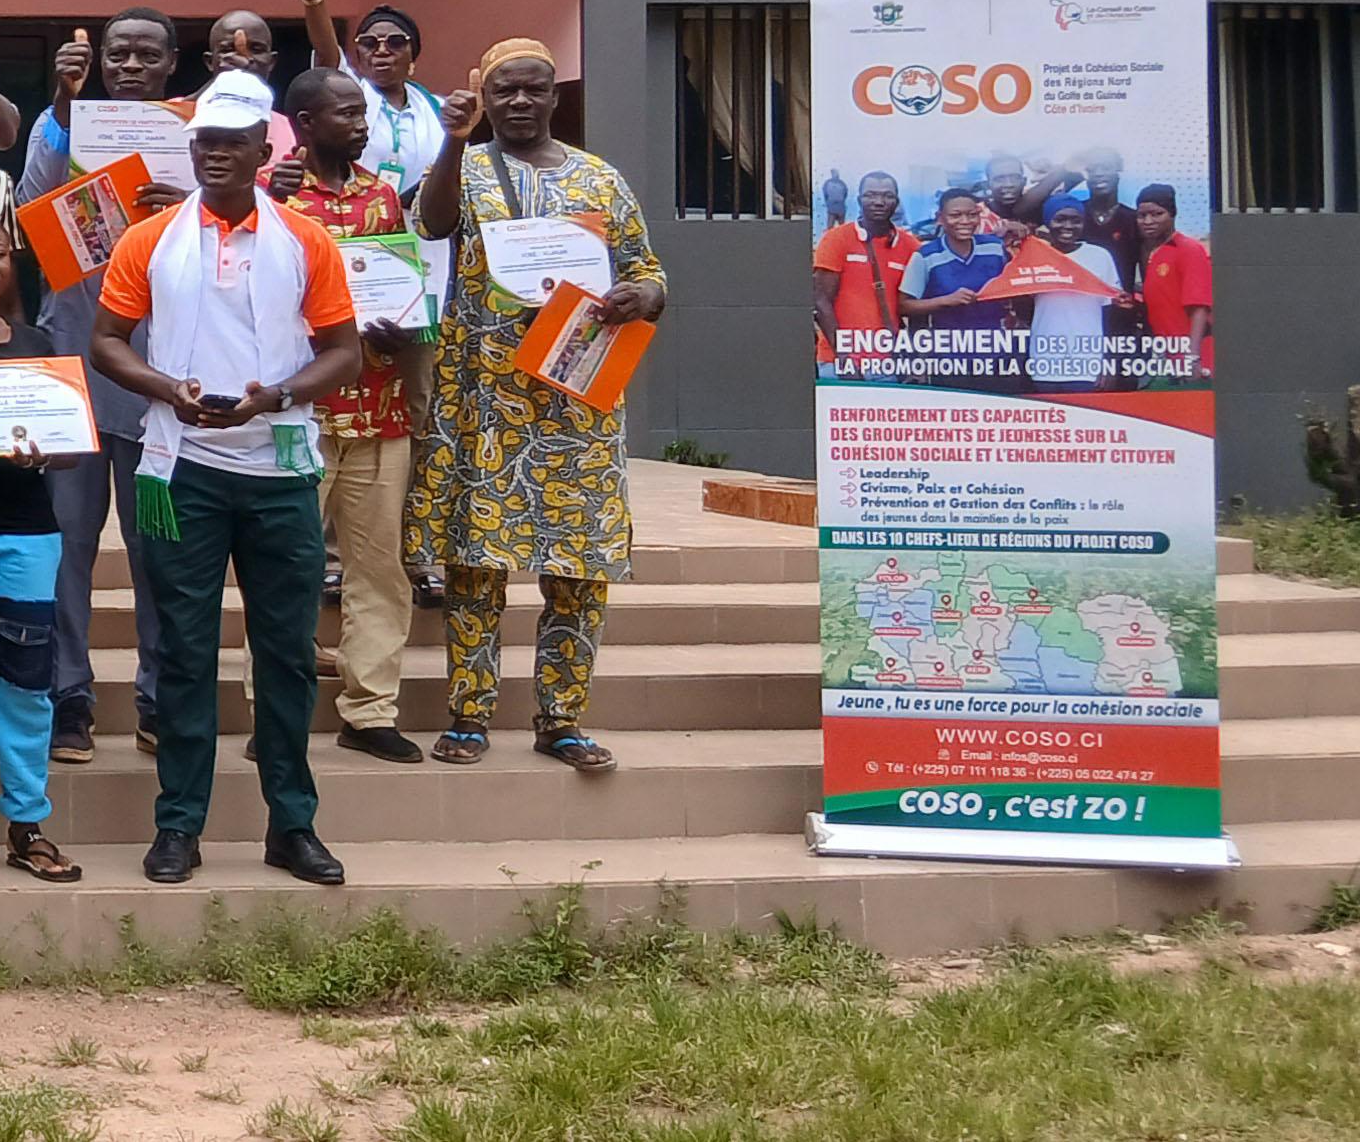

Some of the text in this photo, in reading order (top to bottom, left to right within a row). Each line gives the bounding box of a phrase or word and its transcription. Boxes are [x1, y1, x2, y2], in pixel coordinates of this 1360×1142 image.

[852, 63, 1032, 116] COSO
[836, 329, 1191, 354] ENGAGEMENT DES JEUNES POUR
[835, 359, 856, 375] LA
[860, 358, 967, 376] PROMOTION
[973, 358, 993, 376] DE
[999, 359, 1020, 376] LA
[1121, 359, 1193, 377] SOCIALE
[830, 407, 1066, 424] RENFORCEMENT DES CAPACITÉS
[830, 427, 1128, 444] DES GROUPEMENTS DE JEUNESSE SUR LA
[831, 444, 1176, 464] COHÉSION SOCIALE ET L'ENGAGEMENT CITOYEN
[860, 468, 930, 481] Leadership
[860, 482, 1025, 495] Civisme, Paix et Cohésion
[838, 695, 1203, 718] Jeune tu es une force pour la cohésion sociale
[935, 728, 1103, 748] WWW.COSO.CI
[899, 790, 983, 816] COSO
[1005, 794, 1079, 819] c'est
[1082, 796, 1127, 821] ZO
